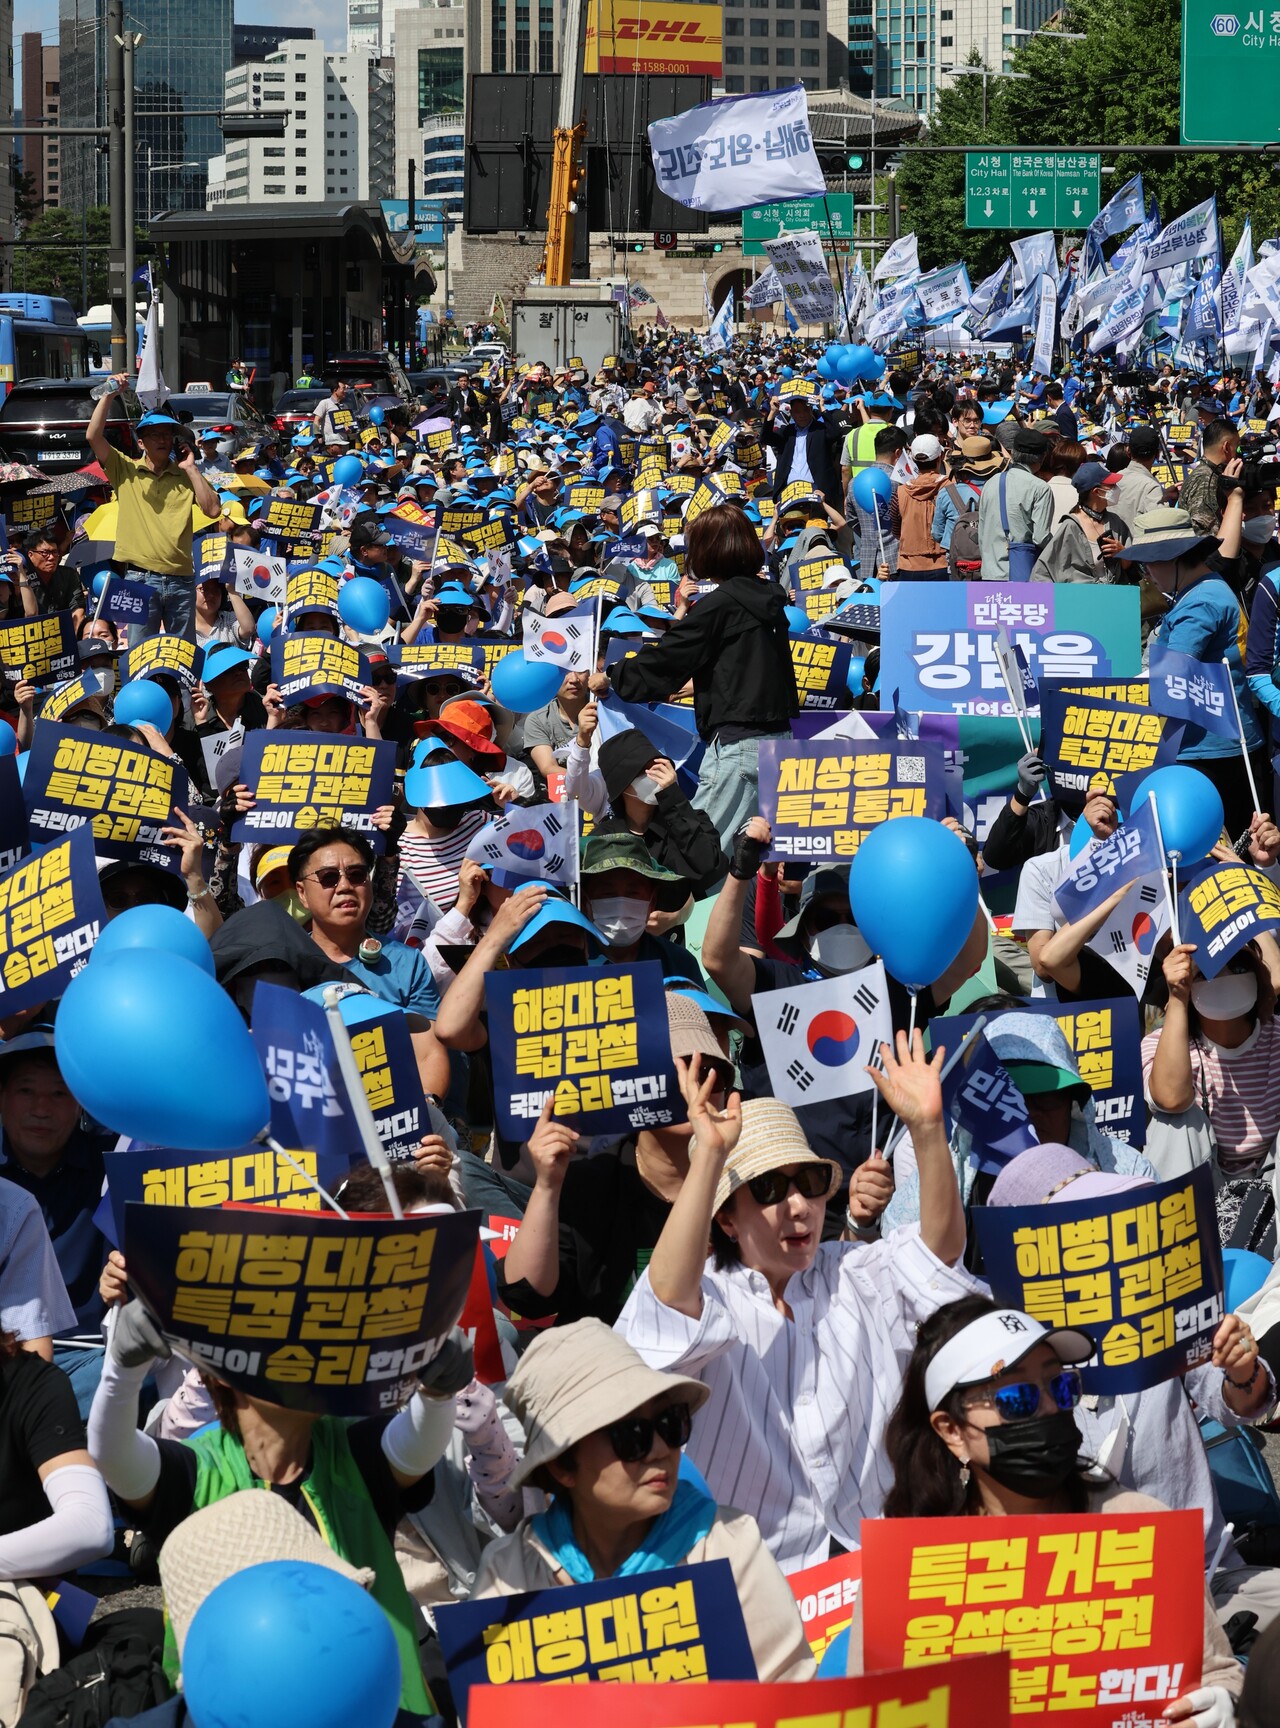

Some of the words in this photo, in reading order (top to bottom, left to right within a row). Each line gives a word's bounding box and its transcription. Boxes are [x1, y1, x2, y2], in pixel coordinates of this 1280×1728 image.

[616, 18, 706, 43] DHL
[1216, 18, 1234, 33] 60
[1242, 34, 1265, 48] City
[643, 62, 690, 74] 1588-0001
[970, 169, 988, 178] City
[991, 169, 1007, 177] Hall
[978, 156, 1001, 168] 시청
[1013, 156, 1054, 168] 한국은행
[1057, 156, 1098, 169] 남산공원
[1013, 169, 1021, 177] The
[1022, 169, 1033, 177] Bank
[1040, 169, 1054, 177] Korea
[1056, 170, 1081, 178] Namsan
[1083, 169, 1098, 178] Park
[659, 233, 672, 244] 50
[269, 501, 315, 518] 해병대원
[110, 594, 144, 613] 민주당
[985, 592, 1012, 605] 더불어
[973, 603, 1048, 626] 민주당
[28, 635, 63, 664] 관철
[283, 637, 360, 664] 해병대원
[22, 654, 75, 681] 승리한다!
[283, 653, 321, 677] 특검
[321, 654, 360, 679] 관철
[279, 675, 311, 696] 국민이
[1062, 705, 1168, 743] 해병대원
[53, 737, 174, 791] 해병대원
[260, 743, 376, 774] 해병대원
[1058, 736, 1107, 769] 특검
[1104, 741, 1160, 772] 관철
[776, 753, 892, 792] 채상병
[1054, 771, 1089, 791] 국민이
[45, 771, 111, 810] 특검
[107, 781, 172, 820] 관철
[255, 775, 312, 804] 특검
[311, 775, 372, 805] 관철
[29, 808, 88, 832] 국민이
[244, 810, 295, 829] 국민이
[775, 792, 850, 828] 특검
[852, 788, 927, 824] 통과
[139, 850, 171, 867] 민주당
[774, 836, 832, 855] 국민의
[11, 879, 76, 948] 관철
[1200, 885, 1260, 933] 특검
[1206, 910, 1256, 958] 국민이
[512, 974, 635, 1034] 해병대원
[516, 1033, 563, 1079] 특검
[565, 1022, 639, 1075] 관철
[553, 1074, 667, 1117] 승리한다!
[961, 1068, 1030, 1123] 민주
[628, 1109, 673, 1128] 민주당
[142, 1149, 321, 1208] 해병대원
[1013, 1184, 1198, 1278] 해병대원
[174, 1228, 437, 1287] 해병대원
[1022, 1271, 1113, 1328] 특검
[1118, 1238, 1203, 1318] 관철
[171, 1286, 297, 1340] 특검
[299, 1283, 430, 1341] 관철
[1101, 1290, 1225, 1367] 승리한다!
[1186, 1341, 1214, 1367] 민주
[907, 1536, 1028, 1607] 특검
[1037, 1525, 1156, 1597] 거부
[482, 1580, 701, 1685] 해병대원
[902, 1594, 1155, 1669] 윤석열정권
[1008, 1662, 1185, 1715] 분노한다!
[1121, 1710, 1146, 1722] 더불어
